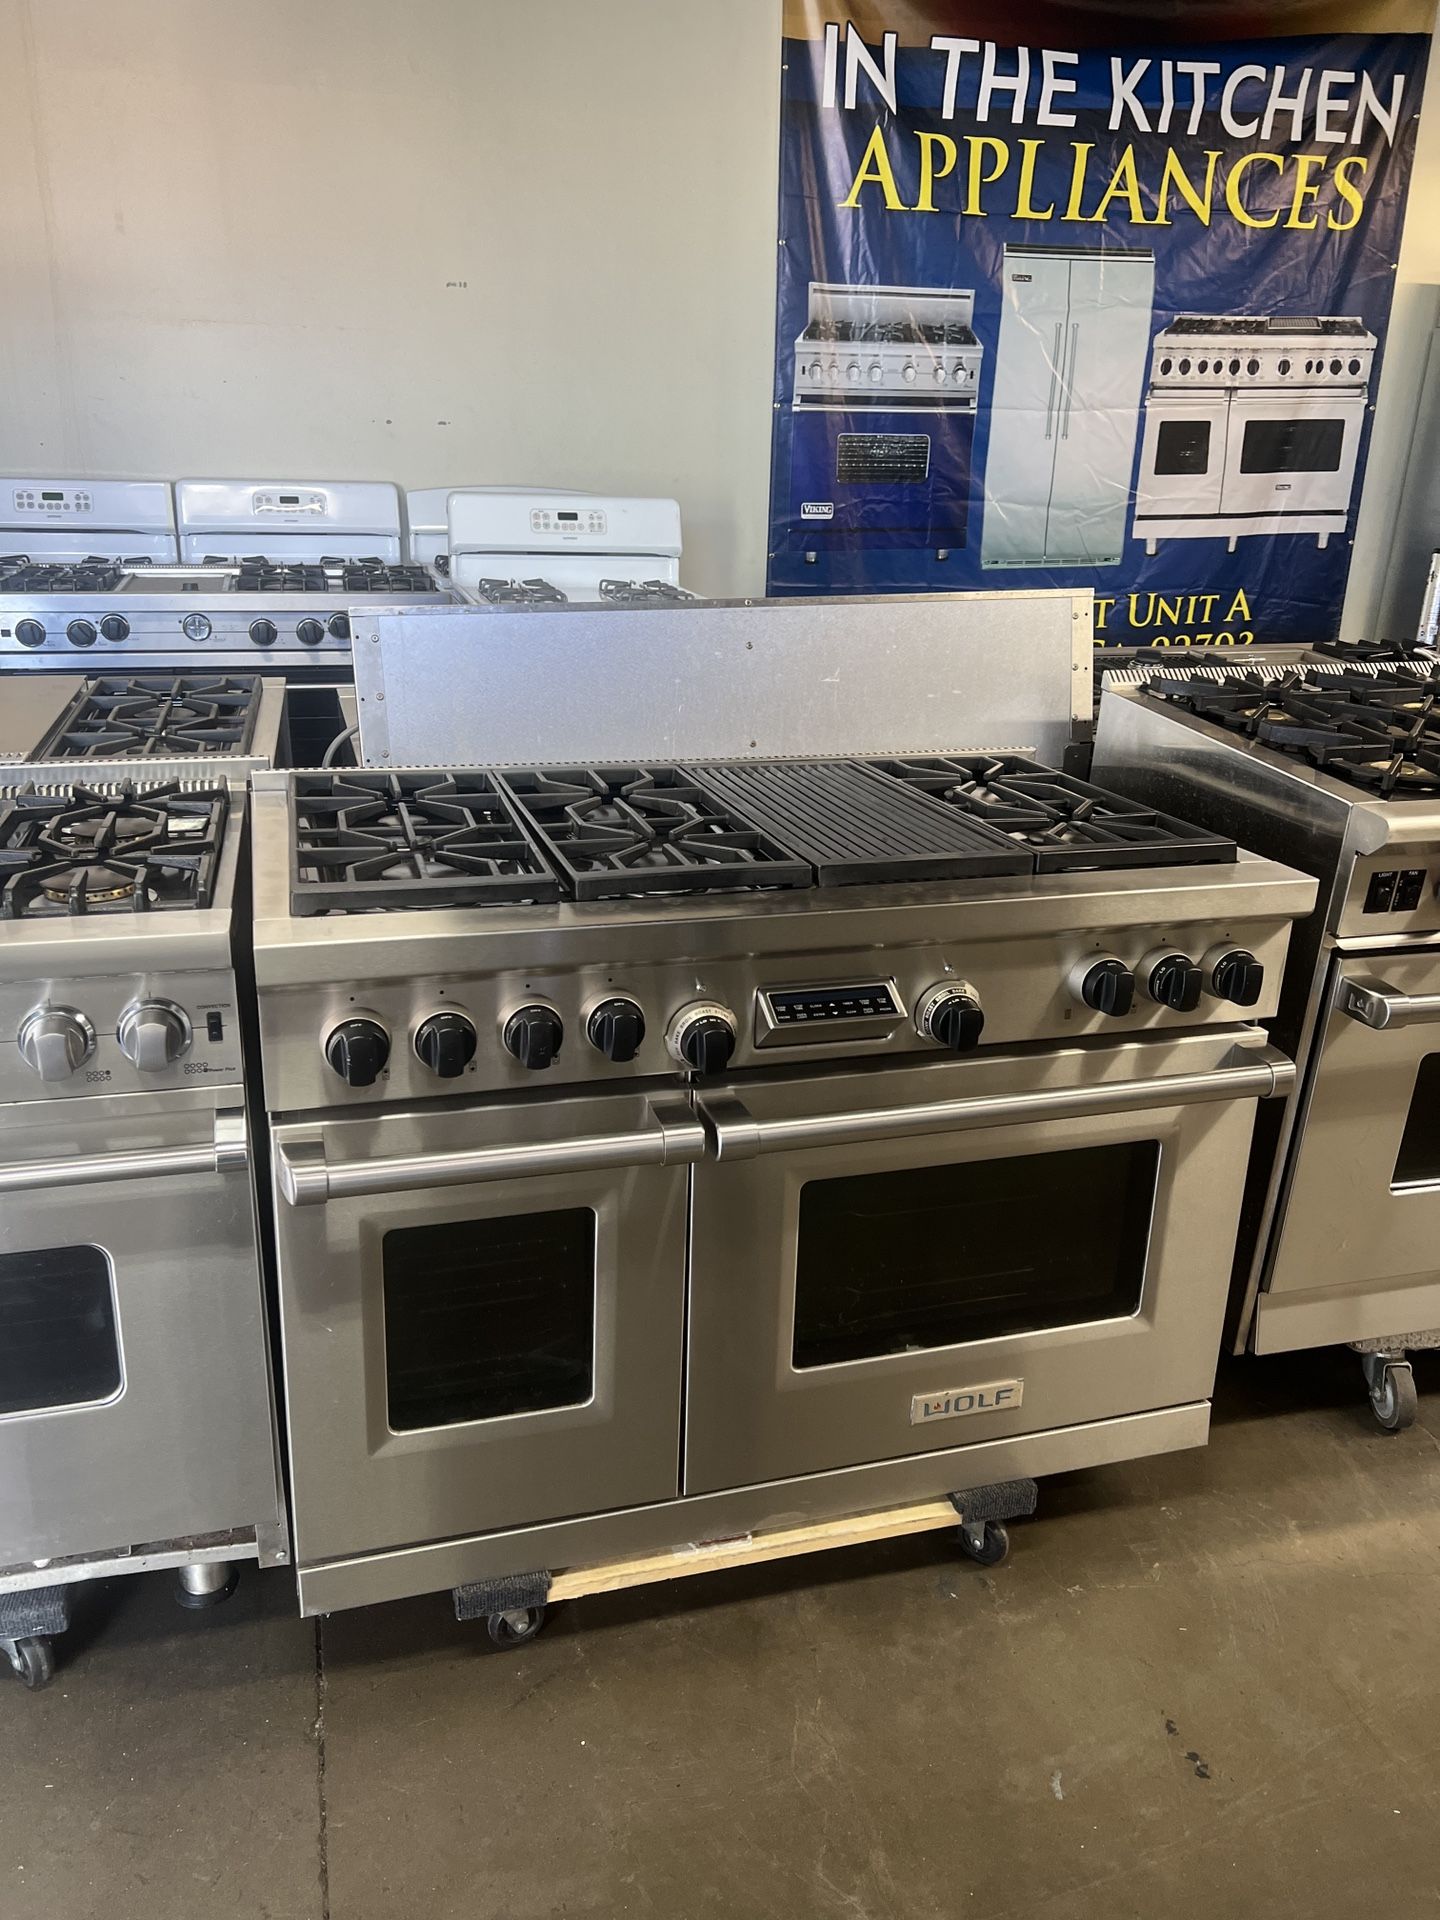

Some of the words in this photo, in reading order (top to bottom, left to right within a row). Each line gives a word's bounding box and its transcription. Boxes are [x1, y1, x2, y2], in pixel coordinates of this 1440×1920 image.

[821, 22, 898, 116] IN
[930, 36, 1080, 128] THE
[1108, 56, 1406, 149] KITCHEN
[836, 123, 1369, 232] APPLIANCES
[1127, 592, 1221, 628] UNIT
[1222, 587, 1253, 623] A
[923, 1388, 1014, 1417] WOLF
